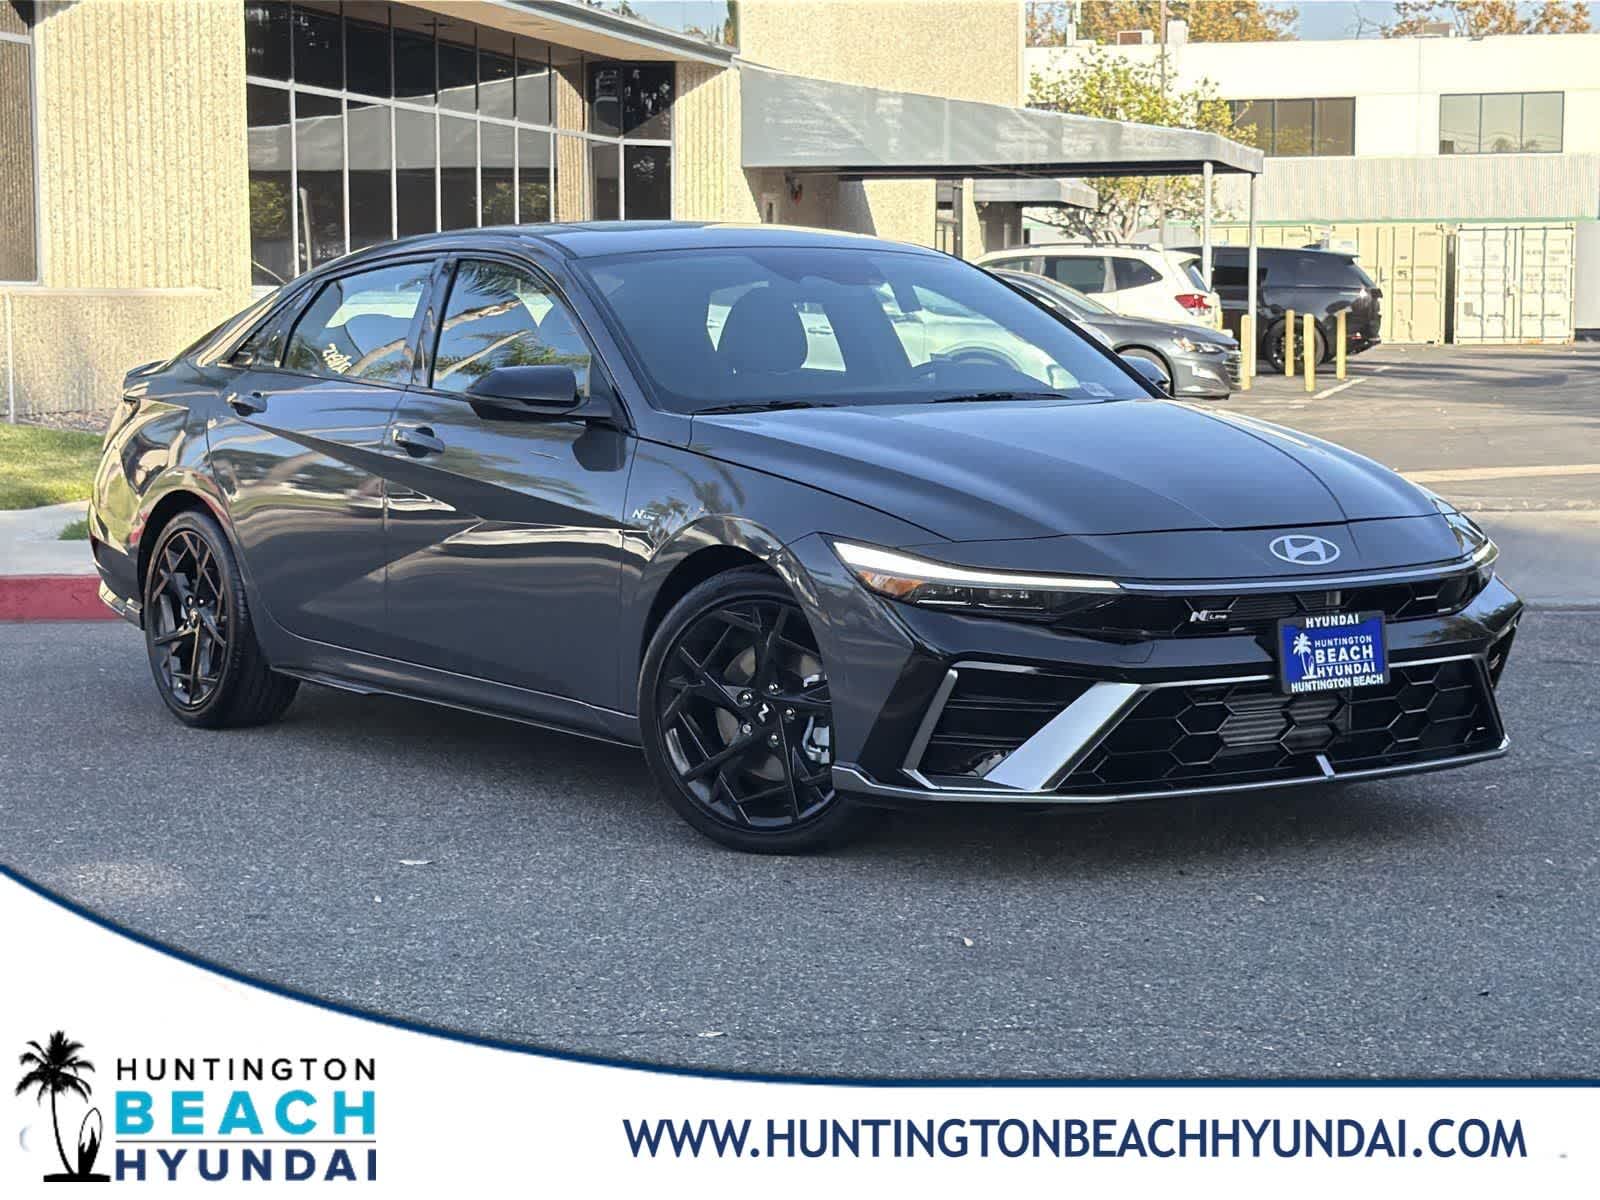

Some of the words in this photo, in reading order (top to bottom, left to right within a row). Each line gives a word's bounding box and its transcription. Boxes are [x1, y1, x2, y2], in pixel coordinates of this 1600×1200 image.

[1305, 613, 1359, 629] HYUNDAI
[1314, 635, 1372, 648] HUNTINGTON
[1315, 644, 1373, 663] BEACH
[1317, 662, 1375, 677] HYUNDAI
[1291, 677, 1352, 693] HUNTINGTON
[1353, 674, 1384, 687] BEACH
